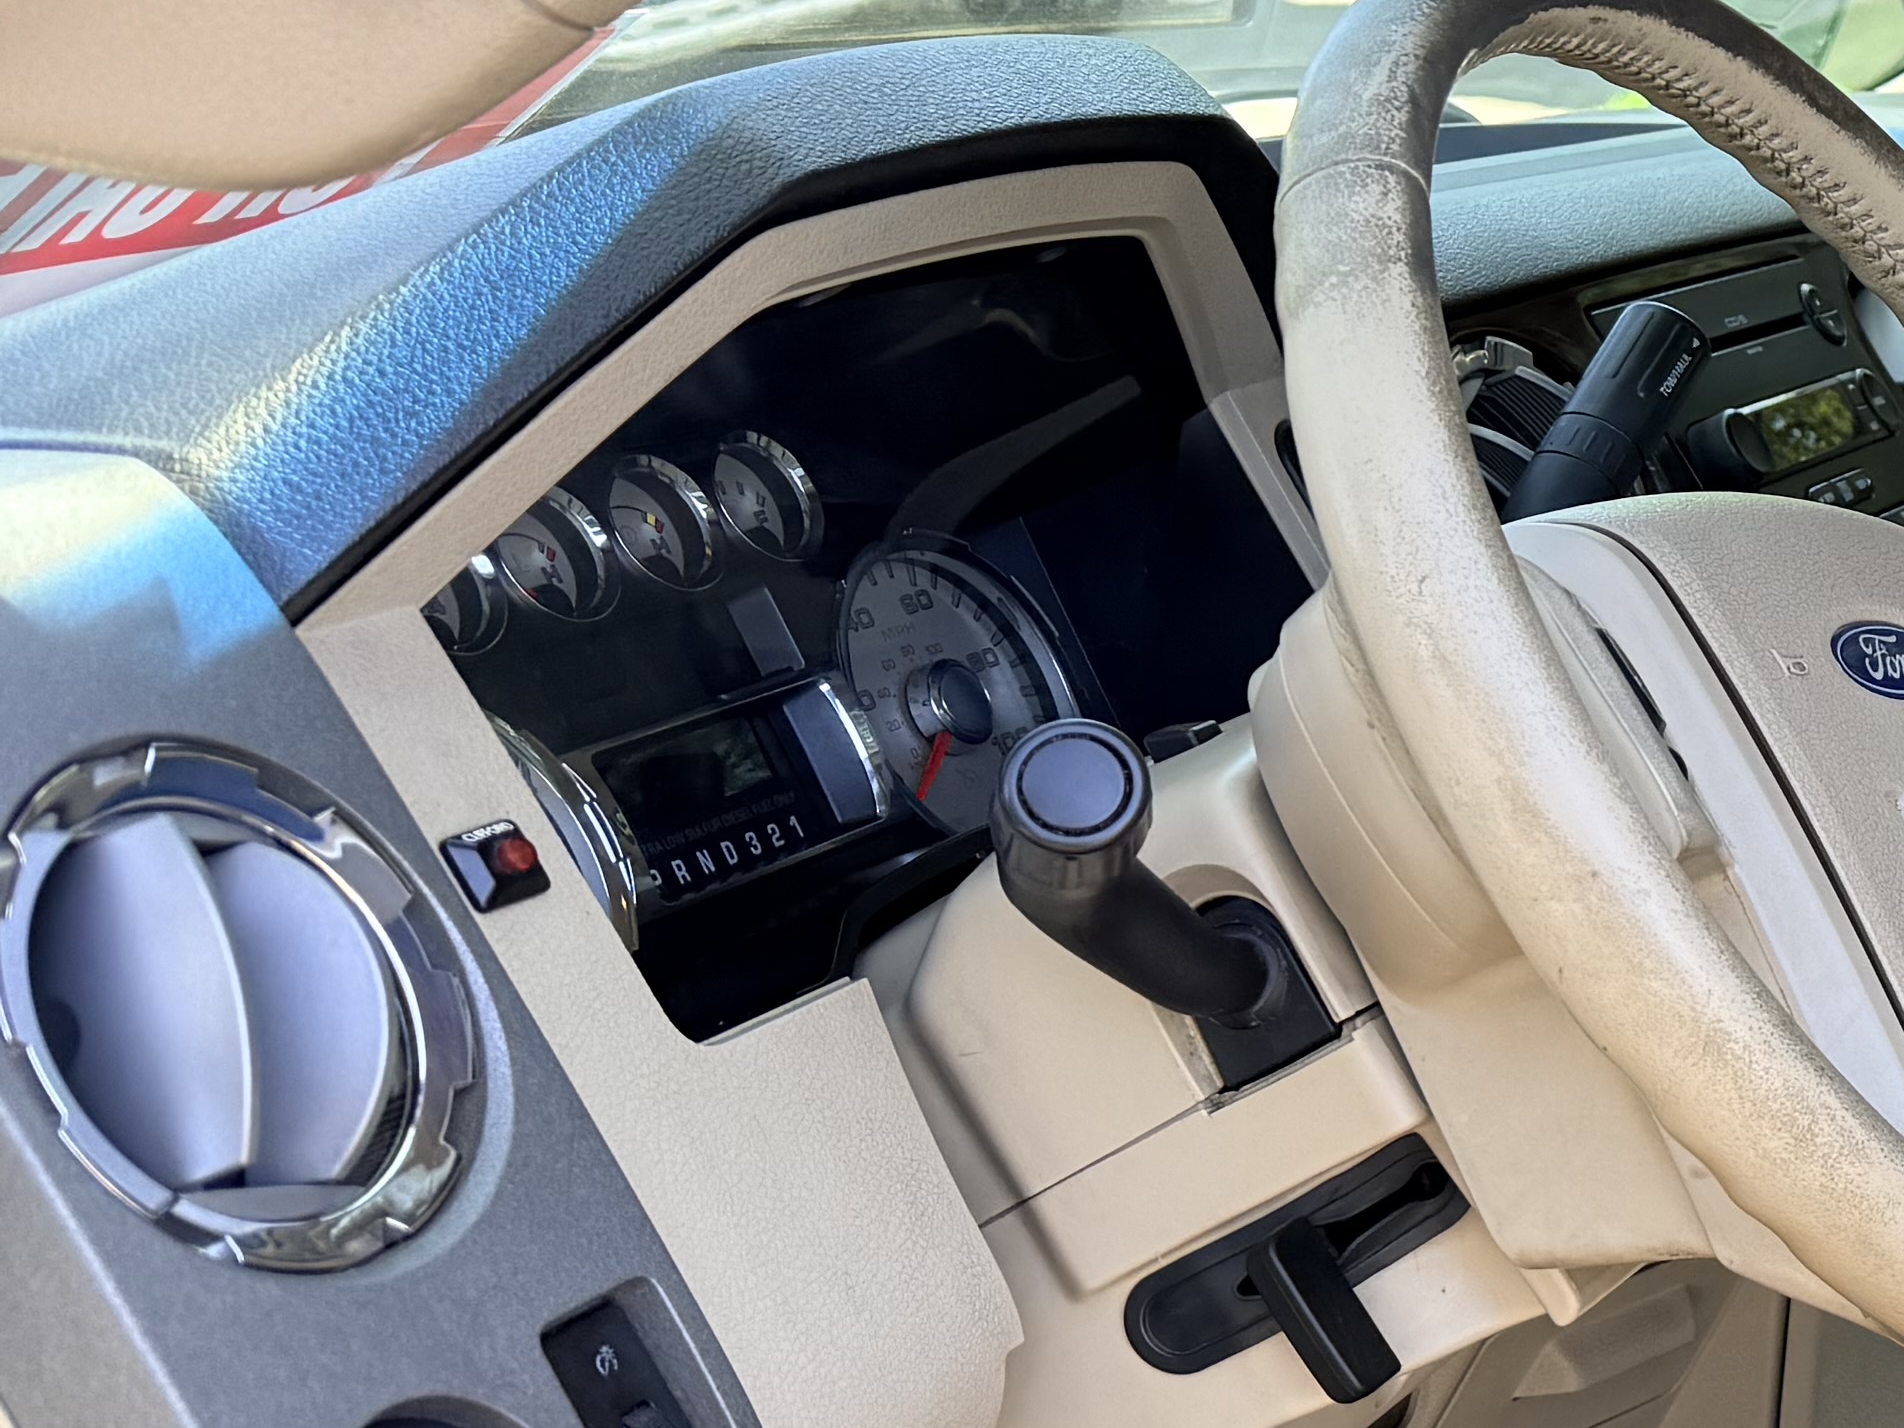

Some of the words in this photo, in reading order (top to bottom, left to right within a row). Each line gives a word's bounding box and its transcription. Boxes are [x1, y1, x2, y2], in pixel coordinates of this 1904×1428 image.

[899, 589, 933, 614] 60
[880, 622, 916, 642] MPH
[966, 647, 1000, 673] 80
[671, 859, 691, 884] R
[696, 849, 717, 875] N
[720, 840, 738, 864] D
[745, 832, 762, 855] 3
[767, 823, 785, 848] 2
[789, 815, 805, 837] 1
